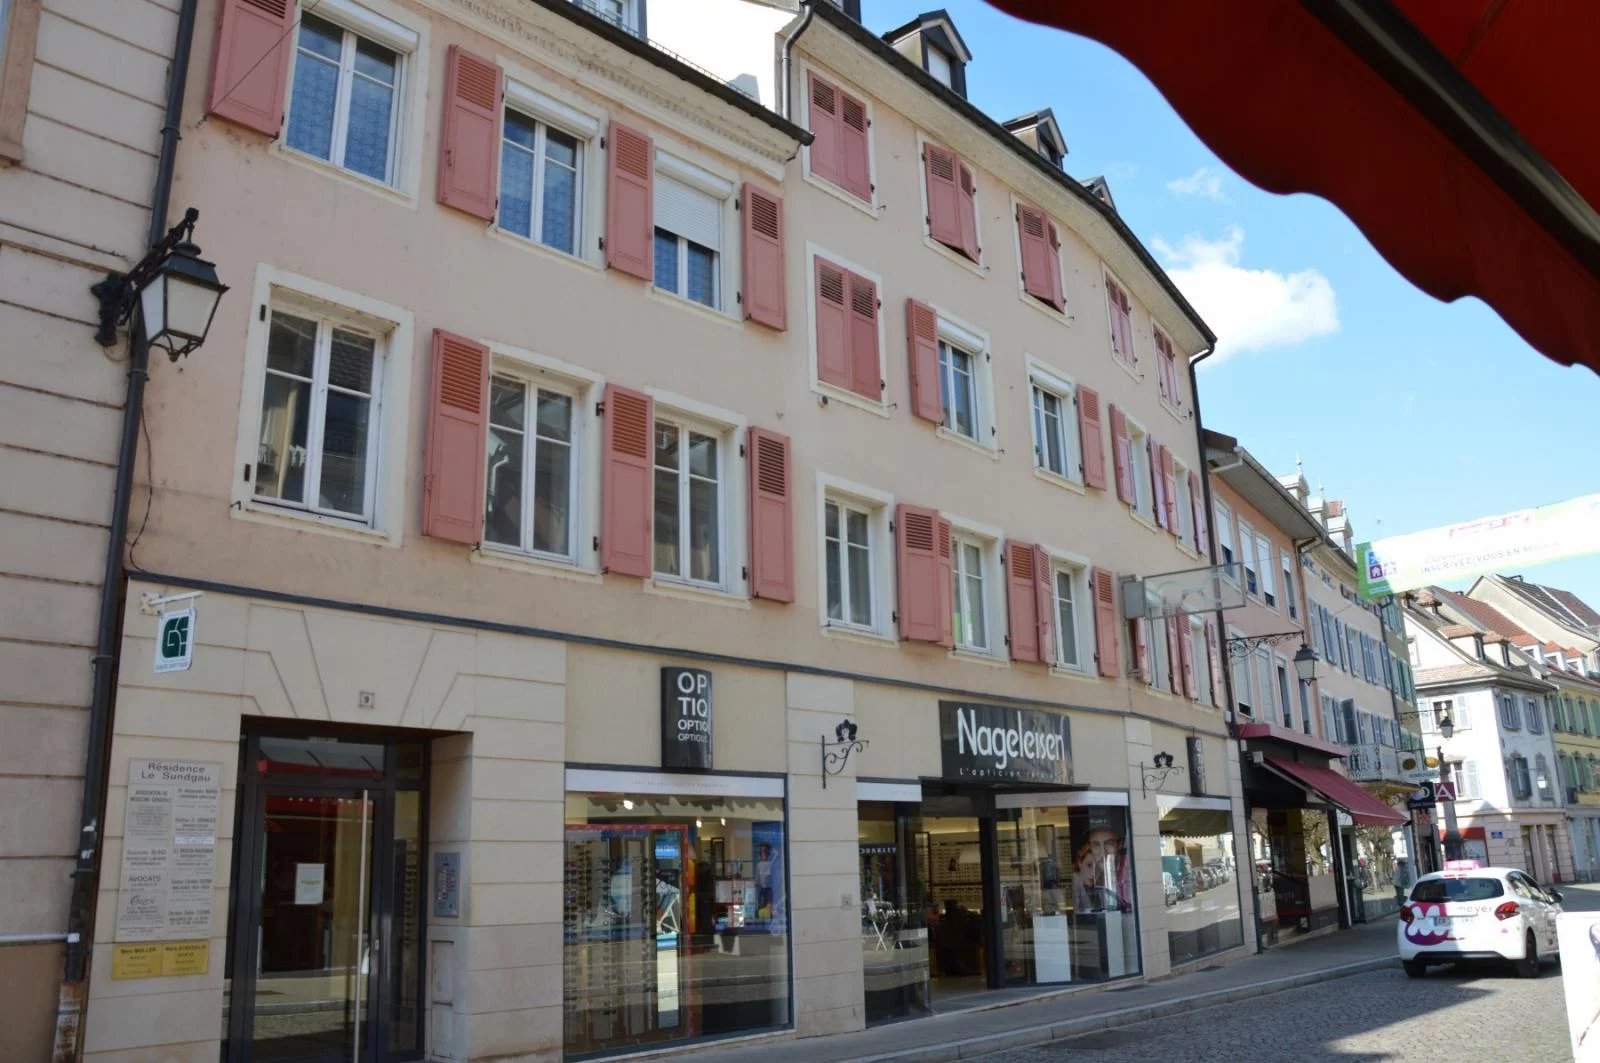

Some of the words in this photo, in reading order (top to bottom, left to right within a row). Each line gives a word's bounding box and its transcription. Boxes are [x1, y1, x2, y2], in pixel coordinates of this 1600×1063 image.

[957, 707, 1065, 770] Nageleisen
[148, 762, 205, 773] Résidence
[141, 771, 155, 779] Le
[162, 772, 211, 783] Sundgau
